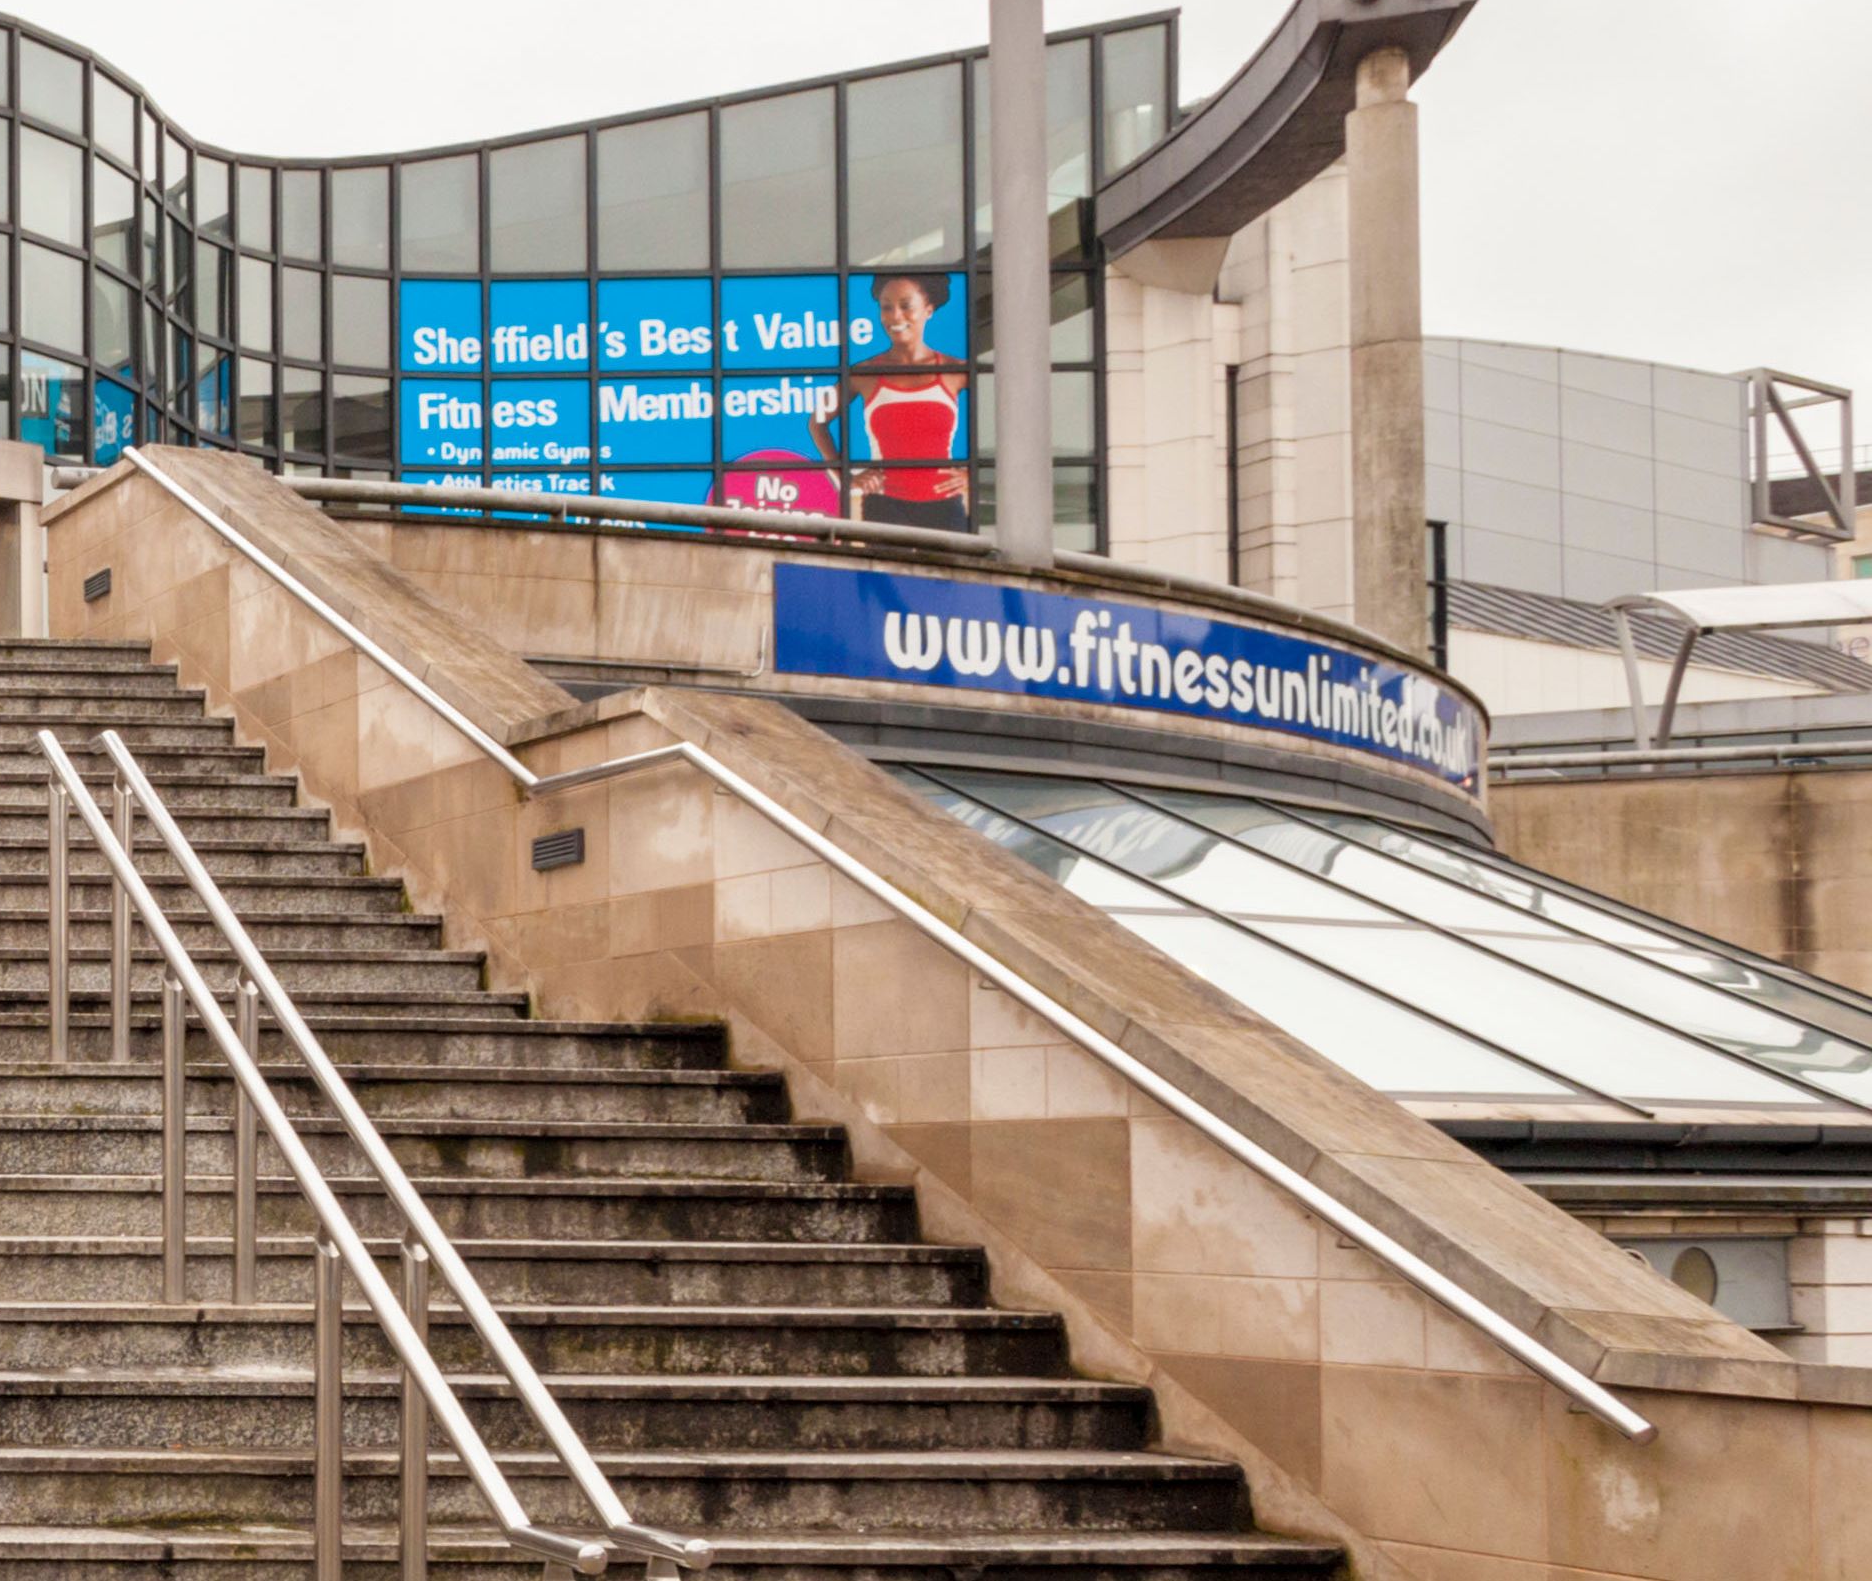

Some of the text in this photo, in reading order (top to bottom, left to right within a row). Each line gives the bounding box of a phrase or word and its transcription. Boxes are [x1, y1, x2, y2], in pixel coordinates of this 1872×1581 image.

[413, 311, 874, 365] Sheffield's Best Value
[418, 376, 839, 430] Fitness Membership
[441, 441, 612, 465] Dynamic Gyms
[547, 473, 616, 492] Track
[756, 475, 798, 502] No
[883, 610, 1467, 776] www.fitnessunlimited.co.uk
